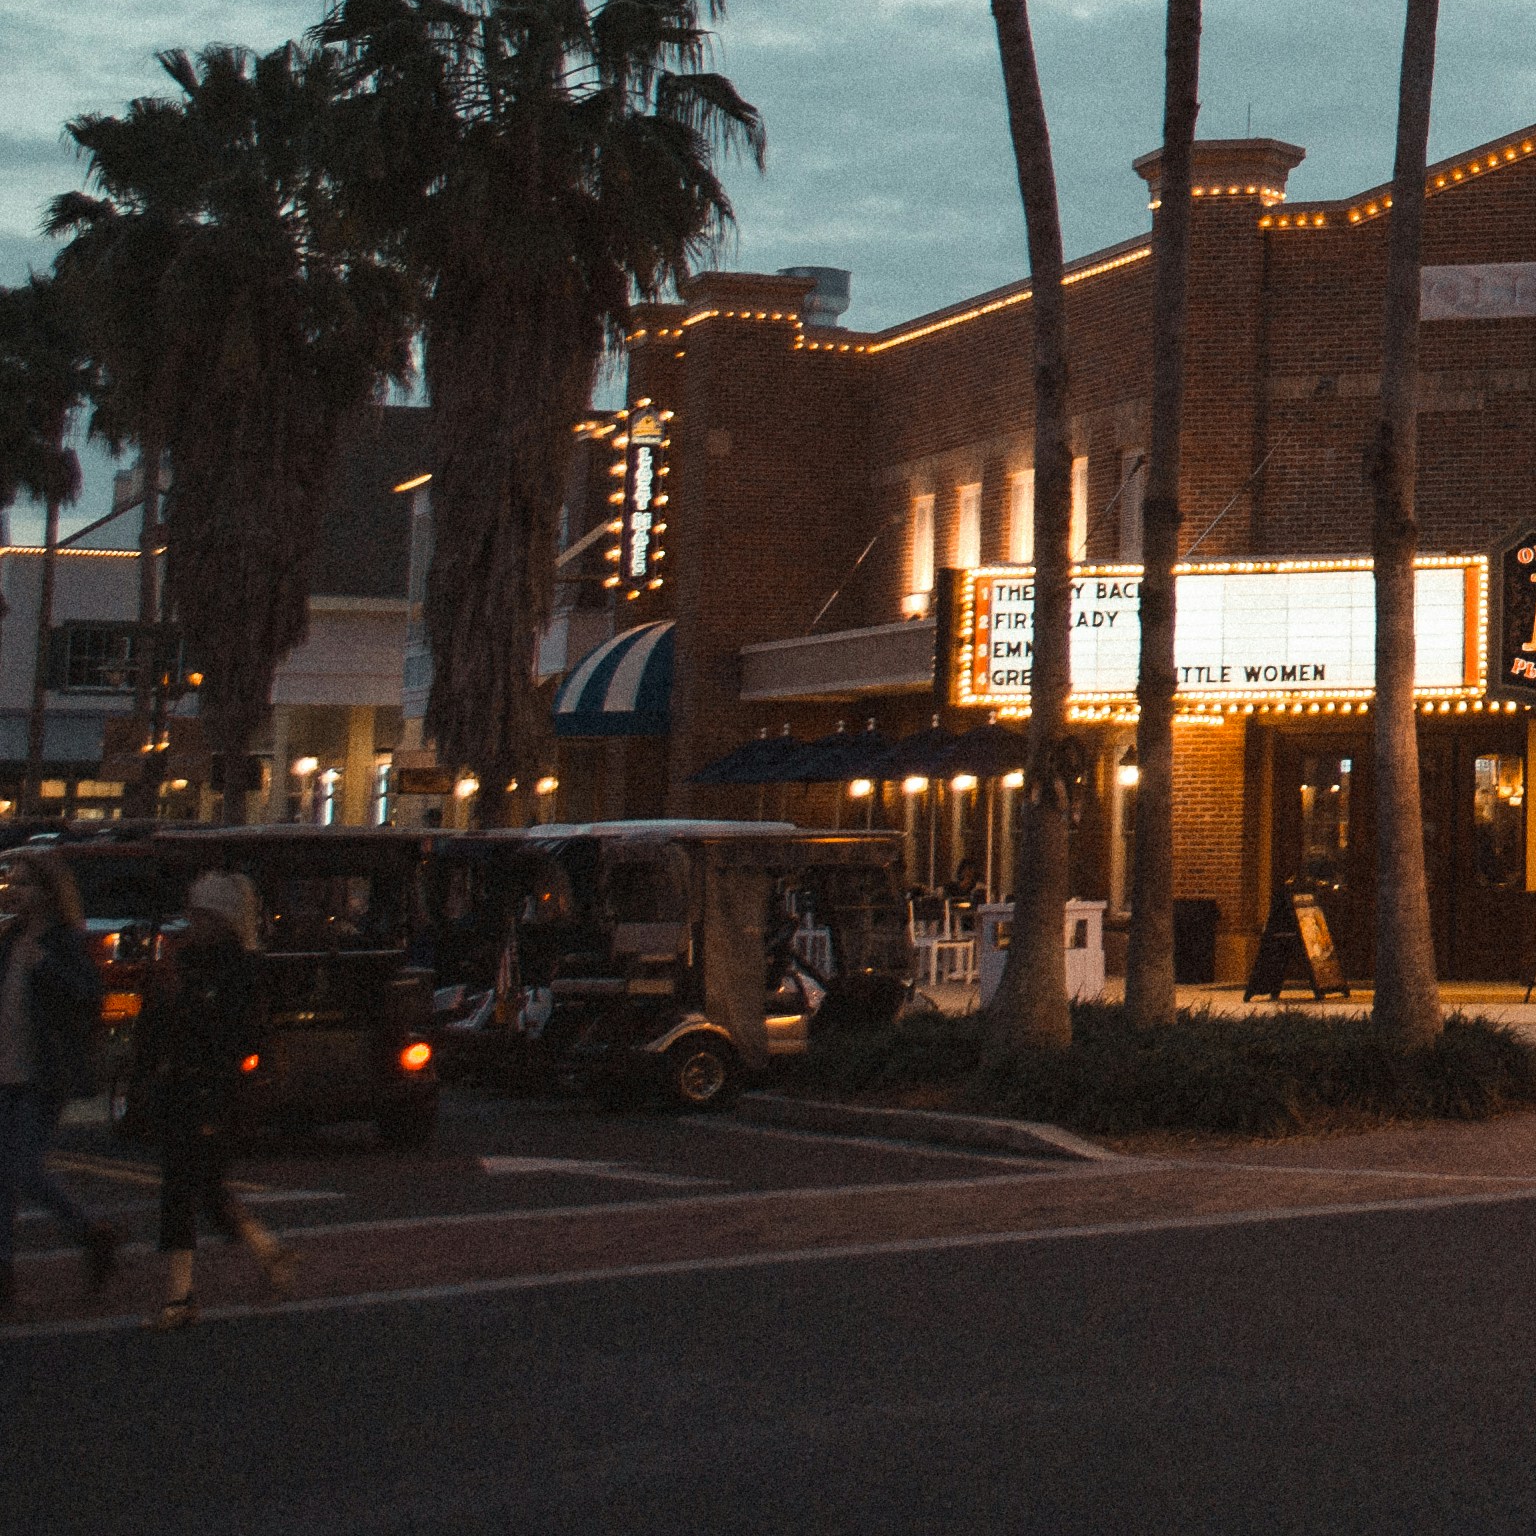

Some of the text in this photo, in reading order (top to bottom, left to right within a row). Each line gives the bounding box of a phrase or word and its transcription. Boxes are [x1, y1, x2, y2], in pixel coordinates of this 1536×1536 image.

[997, 585, 1034, 601] THE
[1096, 582, 1140, 599] BAC
[994, 612, 1034, 629] FIR
[1075, 610, 1119, 627] ADY
[993, 641, 1034, 658] EM
[991, 669, 1032, 686] GRE
[1178, 666, 1232, 683] TTLE
[1243, 664, 1327, 682] WOMEN
